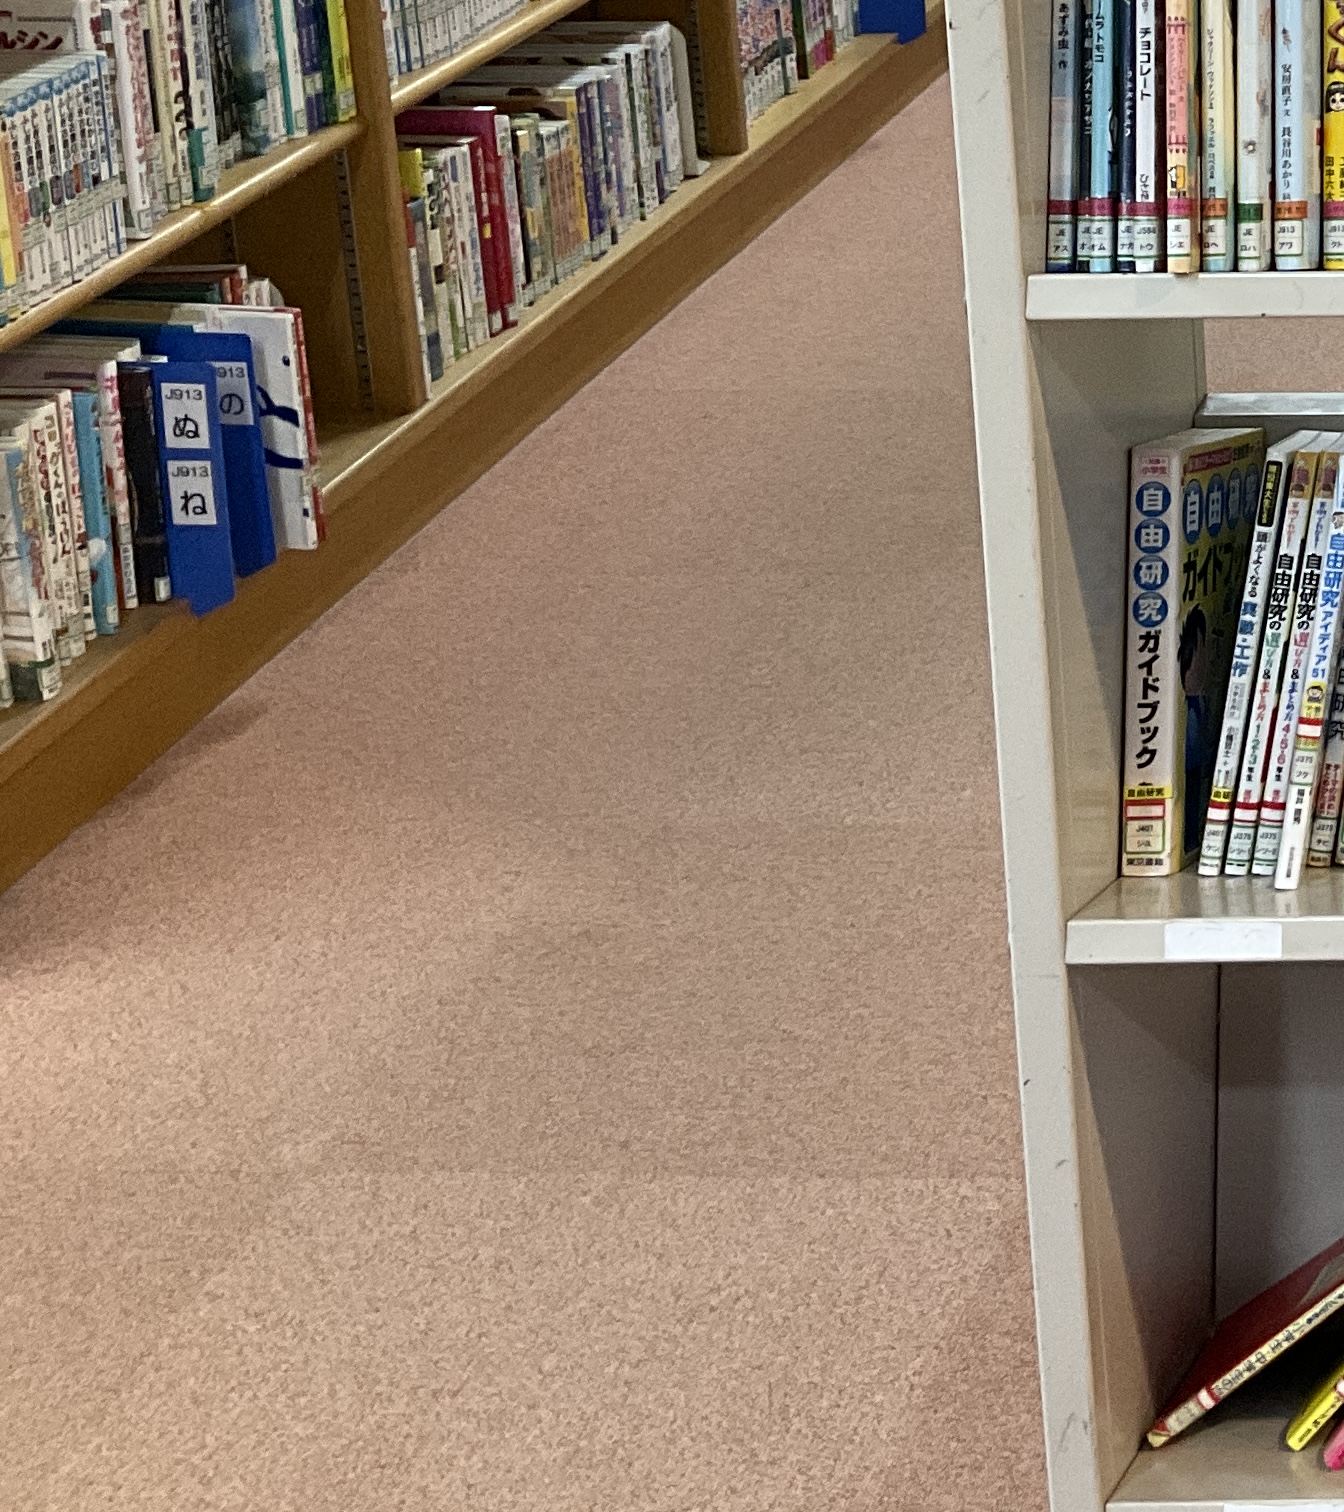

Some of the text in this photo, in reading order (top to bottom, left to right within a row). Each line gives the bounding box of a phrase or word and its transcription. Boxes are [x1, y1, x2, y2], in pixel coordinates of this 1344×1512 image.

[1139, 27, 1152, 101] チョコレート
[215, 366, 245, 379] 913
[165, 388, 204, 401] J913
[219, 392, 245, 416] の
[172, 413, 200, 440] ぬ
[171, 465, 209, 478] J913
[179, 492, 207, 516] ね
[1134, 481, 1171, 770] 自由研究ガイドブック
